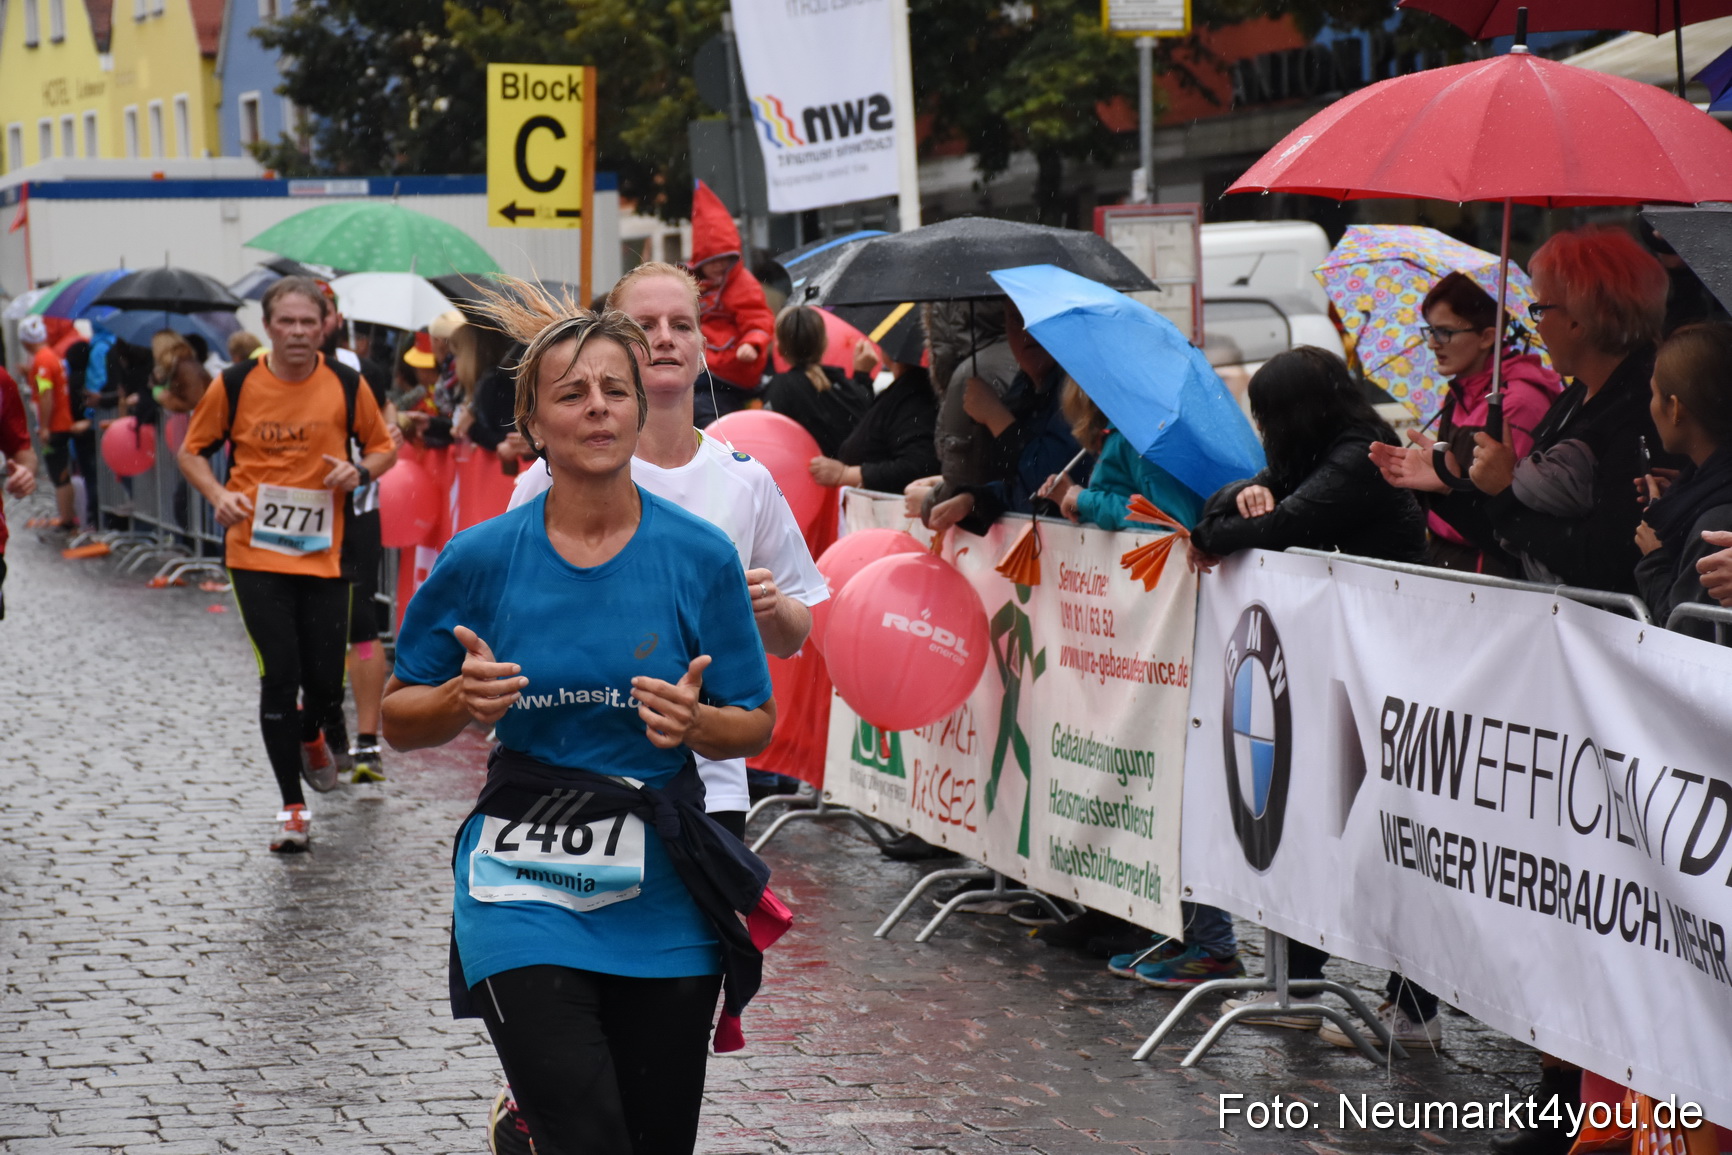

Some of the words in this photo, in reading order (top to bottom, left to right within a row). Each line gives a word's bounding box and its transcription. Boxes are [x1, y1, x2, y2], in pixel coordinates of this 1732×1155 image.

[501, 72, 582, 102] Block
[514, 114, 567, 194] C
[263, 502, 325, 533] 2771
[1090, 606, 1101, 637] 63
[1103, 608, 1116, 639] 52
[1225, 609, 1288, 700] BMW
[1051, 721, 1155, 792] Gebäudereinigung
[1049, 777, 1154, 840] Hausmeisterdienst
[1380, 695, 1473, 801] BMW
[1474, 716, 1732, 888] EFFICIENTD
[515, 867, 596, 893] Antonia
[1380, 810, 1477, 894] WENIGER
[1482, 841, 1669, 954] VERBRAUCH.
[1666, 898, 1732, 988] MEHR
